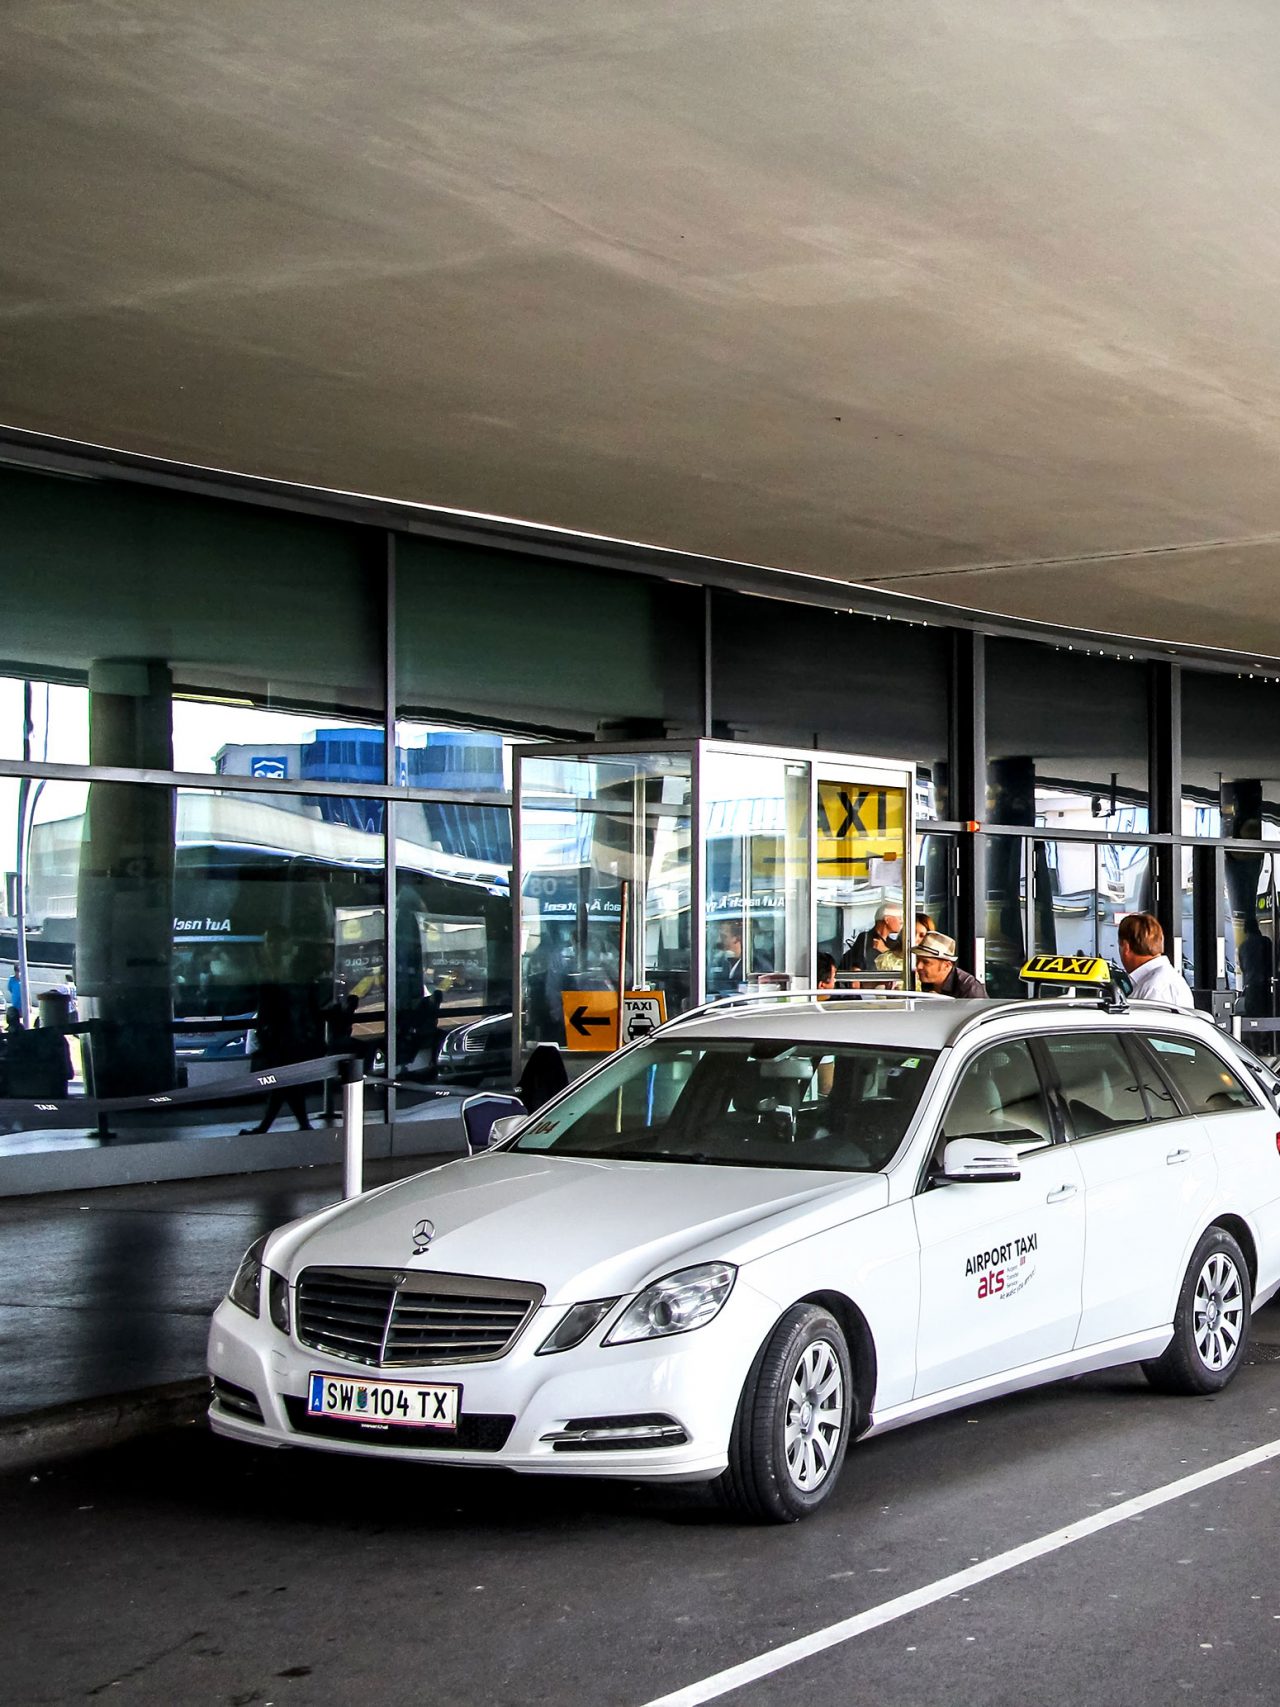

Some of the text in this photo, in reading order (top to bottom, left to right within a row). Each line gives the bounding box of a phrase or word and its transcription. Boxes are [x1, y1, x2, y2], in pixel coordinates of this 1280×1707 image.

[798, 792, 887, 838] AXI
[1034, 956, 1094, 974] TAXI
[625, 1002, 653, 1011] TAXI
[257, 1075, 277, 1086] TAXI
[527, 1120, 561, 1135] 104
[965, 1232, 1038, 1277] AIRPORT TAXI
[977, 1269, 1005, 1299] ats
[326, 1382, 354, 1412] SW
[370, 1387, 410, 1416] 104
[417, 1391, 448, 1420] TX
